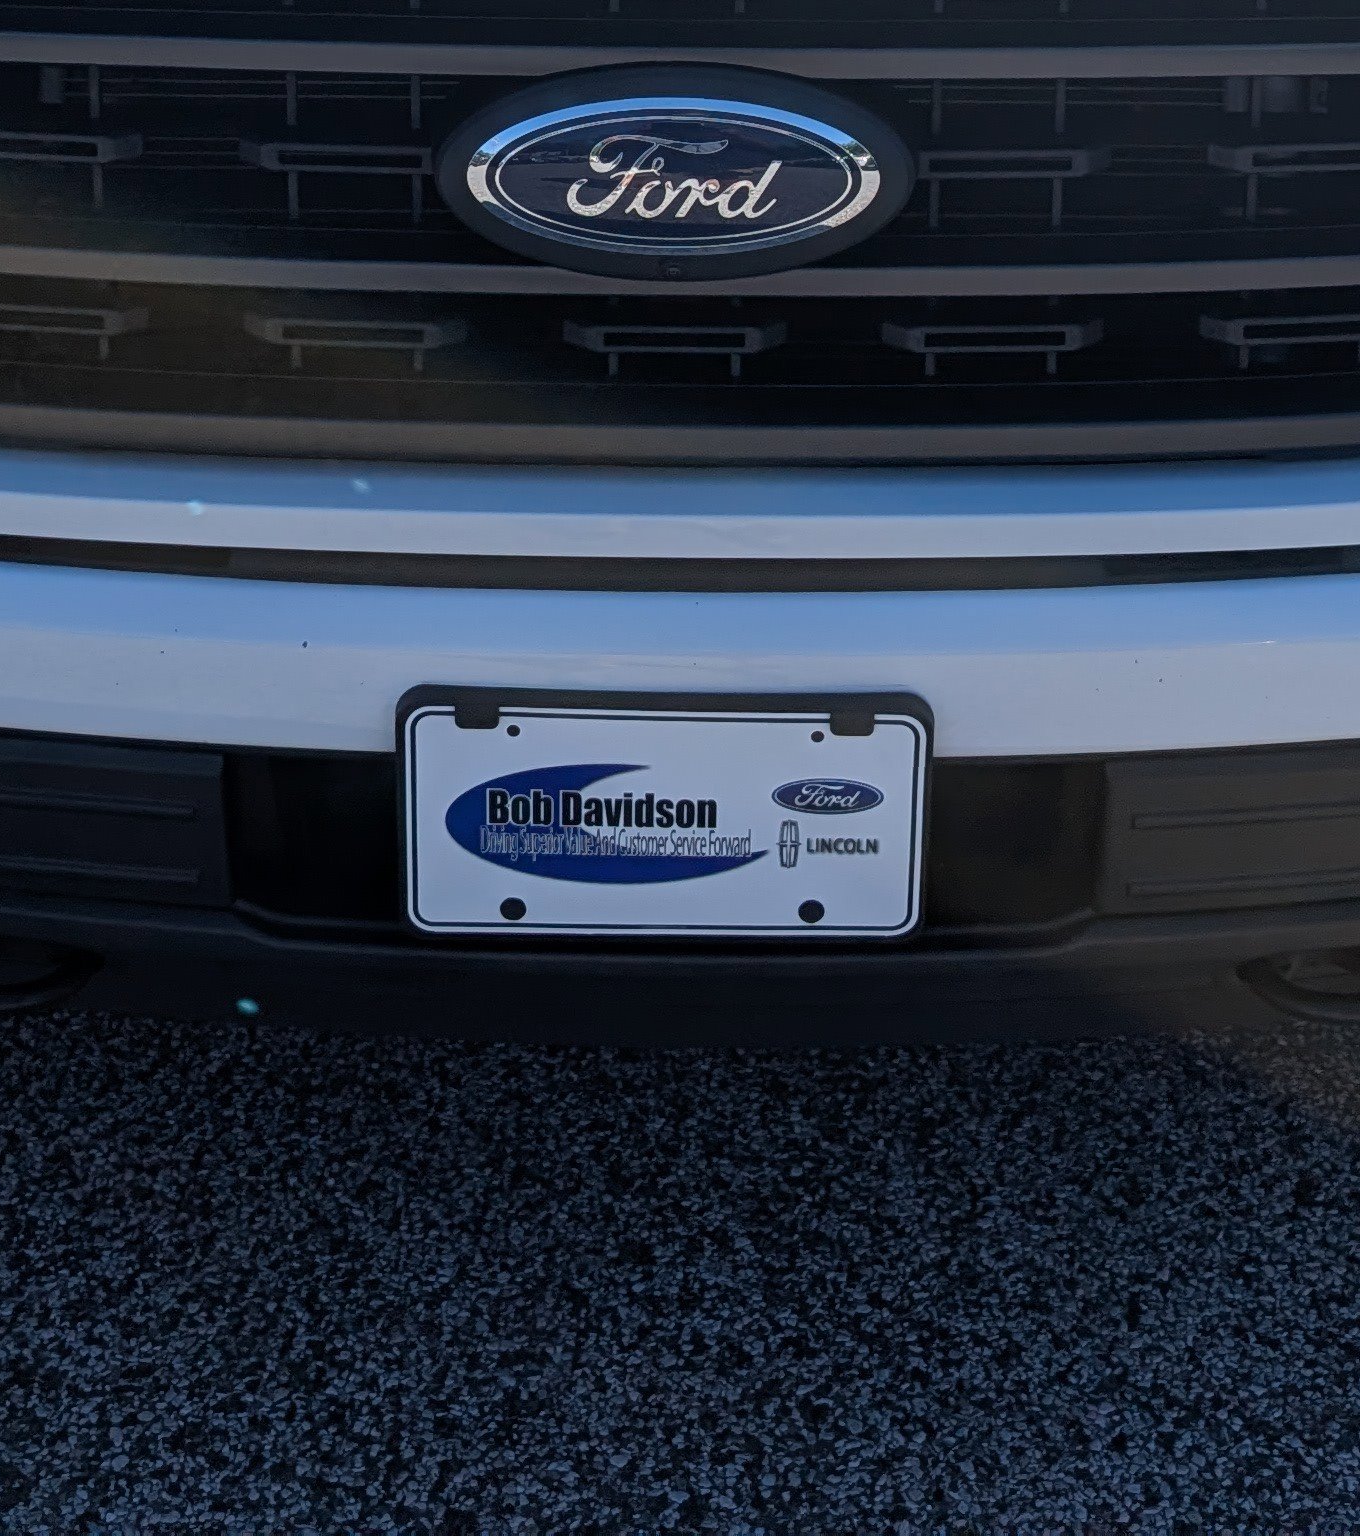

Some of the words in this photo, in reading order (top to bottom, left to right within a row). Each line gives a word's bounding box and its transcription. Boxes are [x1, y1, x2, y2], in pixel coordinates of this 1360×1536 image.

[566, 134, 783, 219] Ford
[486, 788, 554, 827] Bob
[559, 790, 717, 828] Davidson
[794, 783, 861, 808] Ford
[480, 825, 519, 861] Driving
[520, 825, 563, 861] Superior
[564, 826, 595, 856] Value
[595, 827, 617, 856] And
[618, 828, 668, 856] Customer
[670, 829, 707, 856] Service
[709, 828, 752, 856] Forward
[806, 837, 879, 854] LINCOLN
